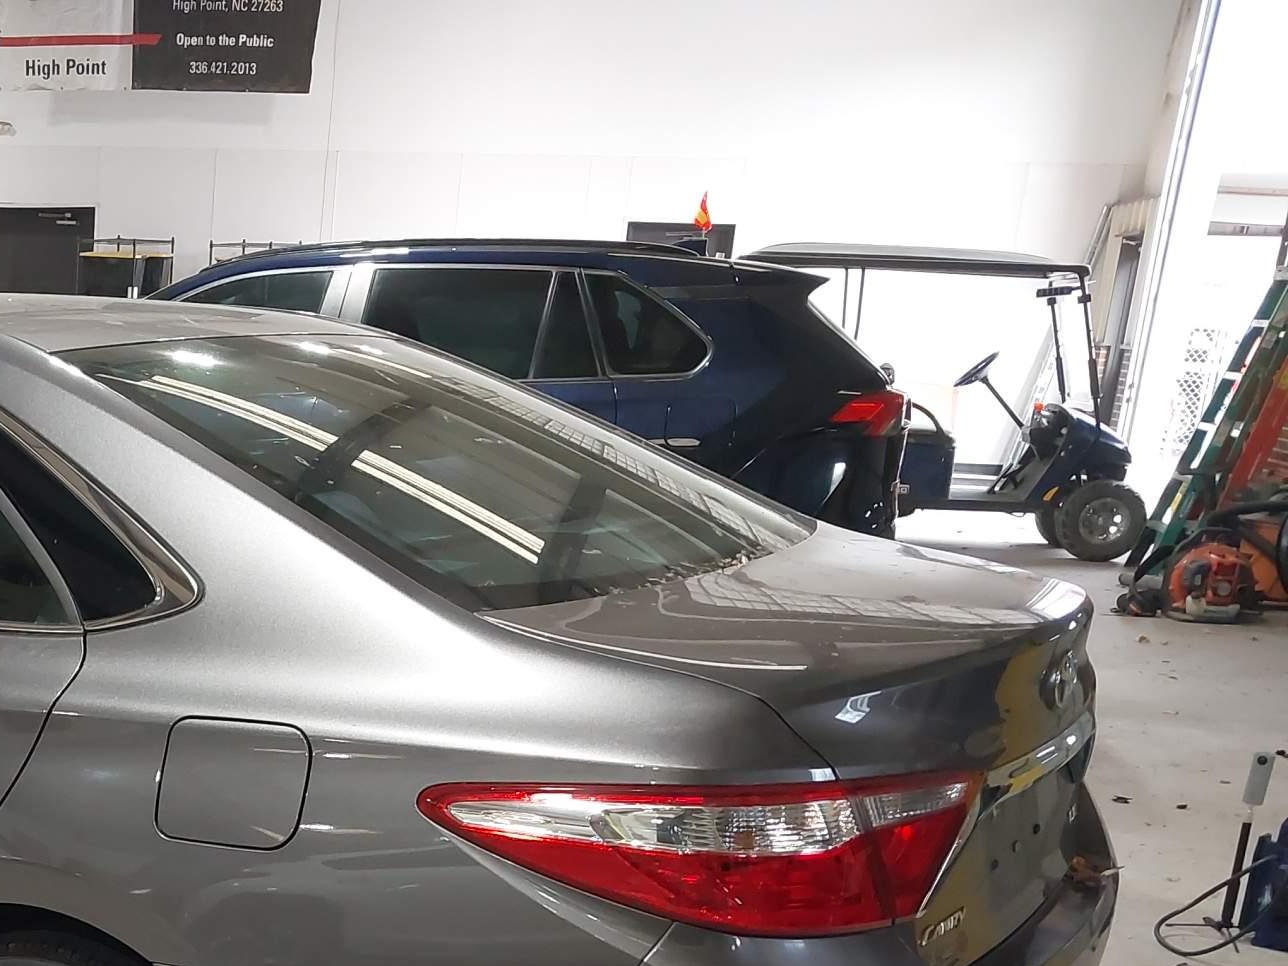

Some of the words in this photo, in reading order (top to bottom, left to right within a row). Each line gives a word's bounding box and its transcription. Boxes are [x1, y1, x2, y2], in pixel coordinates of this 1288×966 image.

[173, 0, 196, 13] High
[200, 0, 228, 12] Point,
[232, 0, 248, 11] NC
[251, 0, 283, 12] 27263
[176, 33, 203, 48] Open
[206, 34, 216, 46] to
[218, 34, 235, 46] the
[238, 34, 274, 47] Public
[25, 59, 59, 80] High
[66, 58, 106, 76] Point
[189, 61, 257, 75] 336.421.2013
